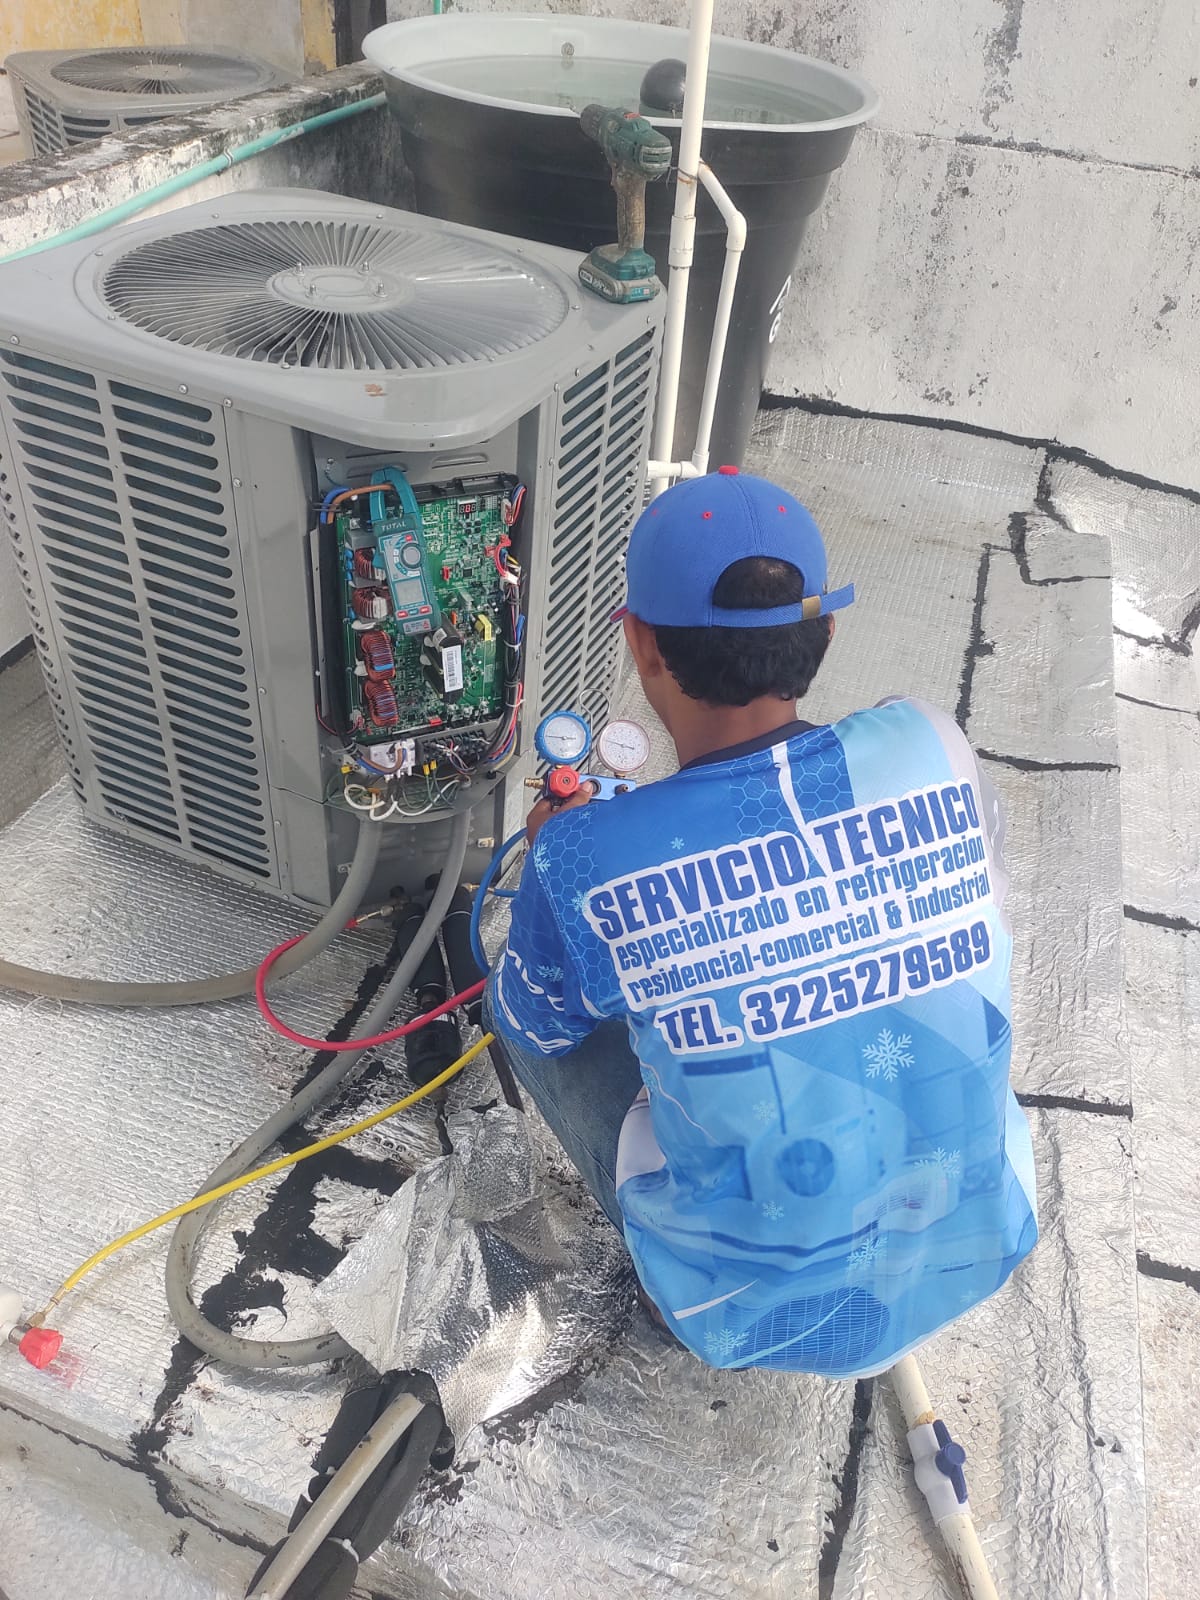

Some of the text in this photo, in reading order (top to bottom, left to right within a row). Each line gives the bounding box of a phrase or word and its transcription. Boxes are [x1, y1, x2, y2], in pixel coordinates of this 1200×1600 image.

[382, 521, 406, 530] TOTAL
[589, 783, 979, 939] SERVICIO TECNICO
[616, 834, 986, 972] especializado en refrigeracion
[883, 900, 902, 929] &
[907, 869, 990, 923] industrial
[658, 920, 990, 1049] TEL. 3225279589
